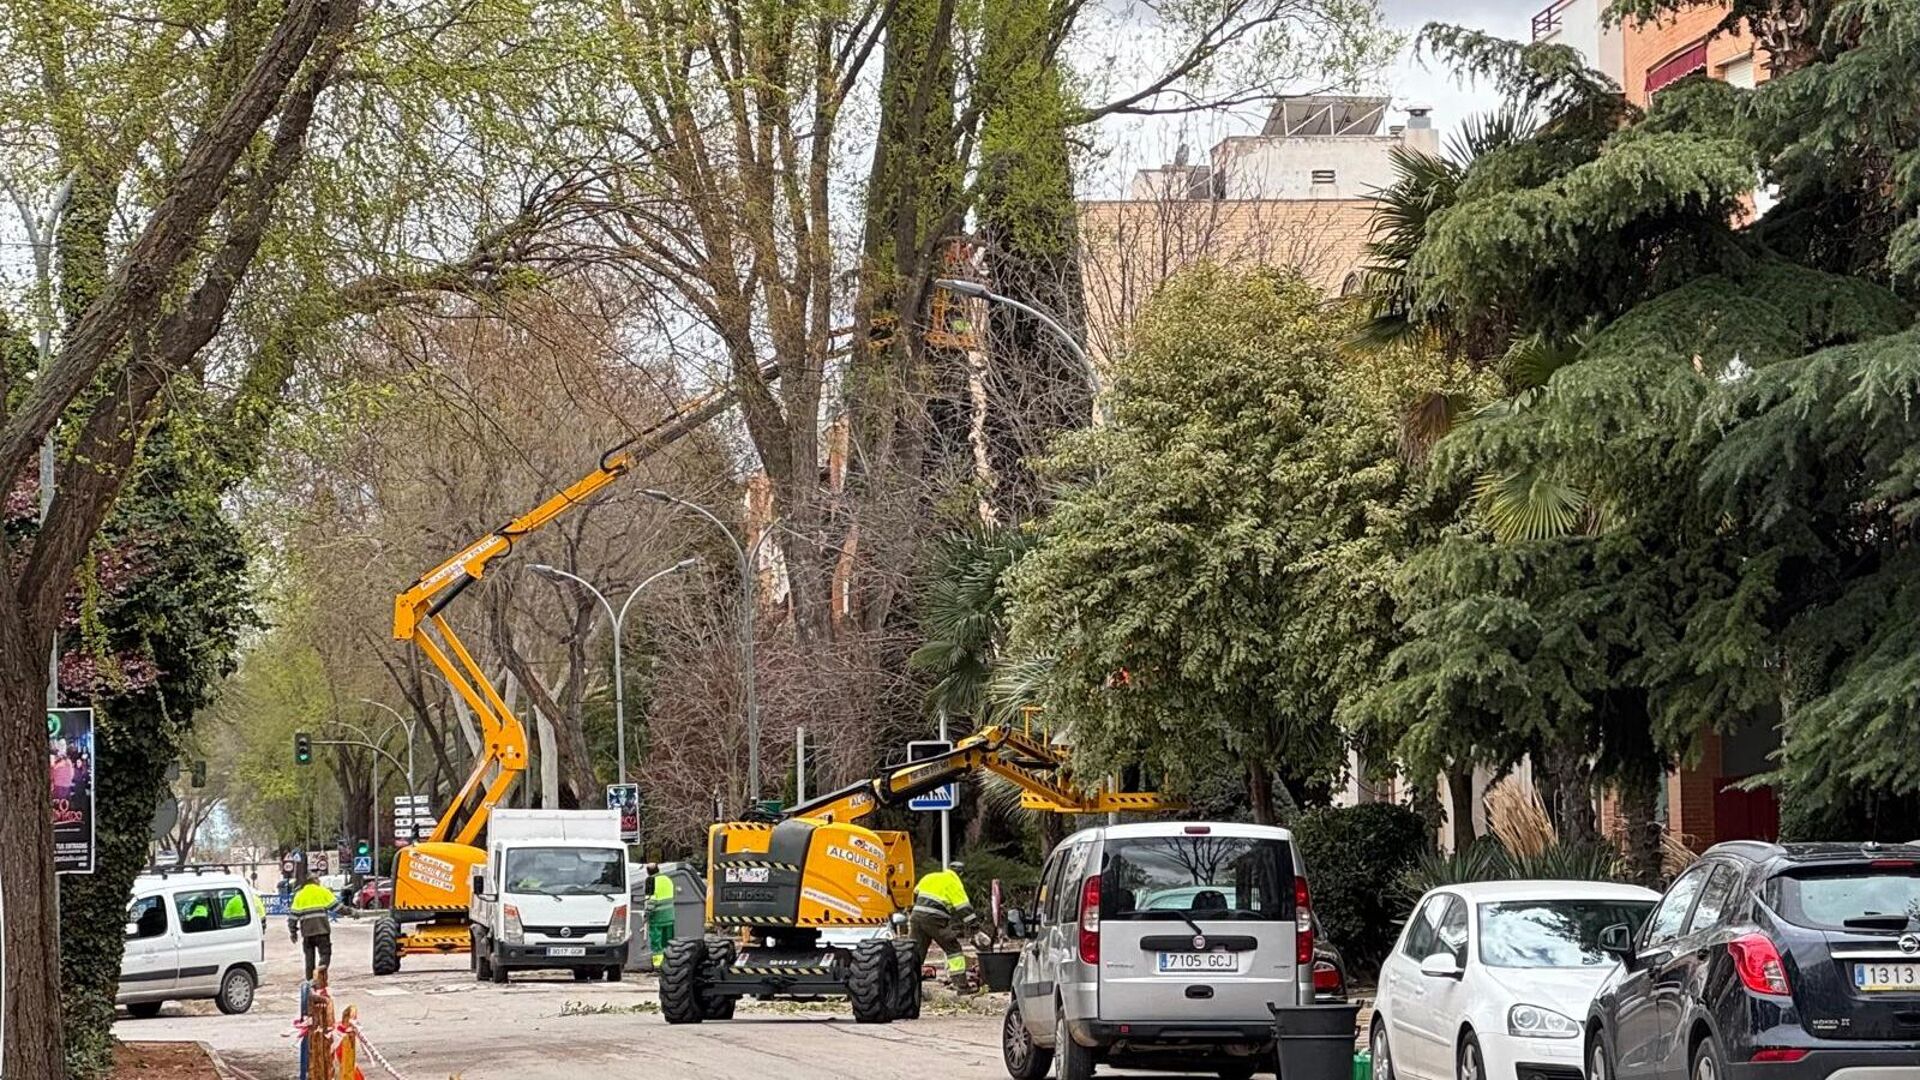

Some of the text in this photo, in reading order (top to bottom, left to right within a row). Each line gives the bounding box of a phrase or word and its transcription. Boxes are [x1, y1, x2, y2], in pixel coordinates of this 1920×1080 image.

[829, 847, 878, 872] ALQUILER
[1169, 954, 1232, 968] 7105 GCJ
[1870, 966, 1914, 984] 1313
